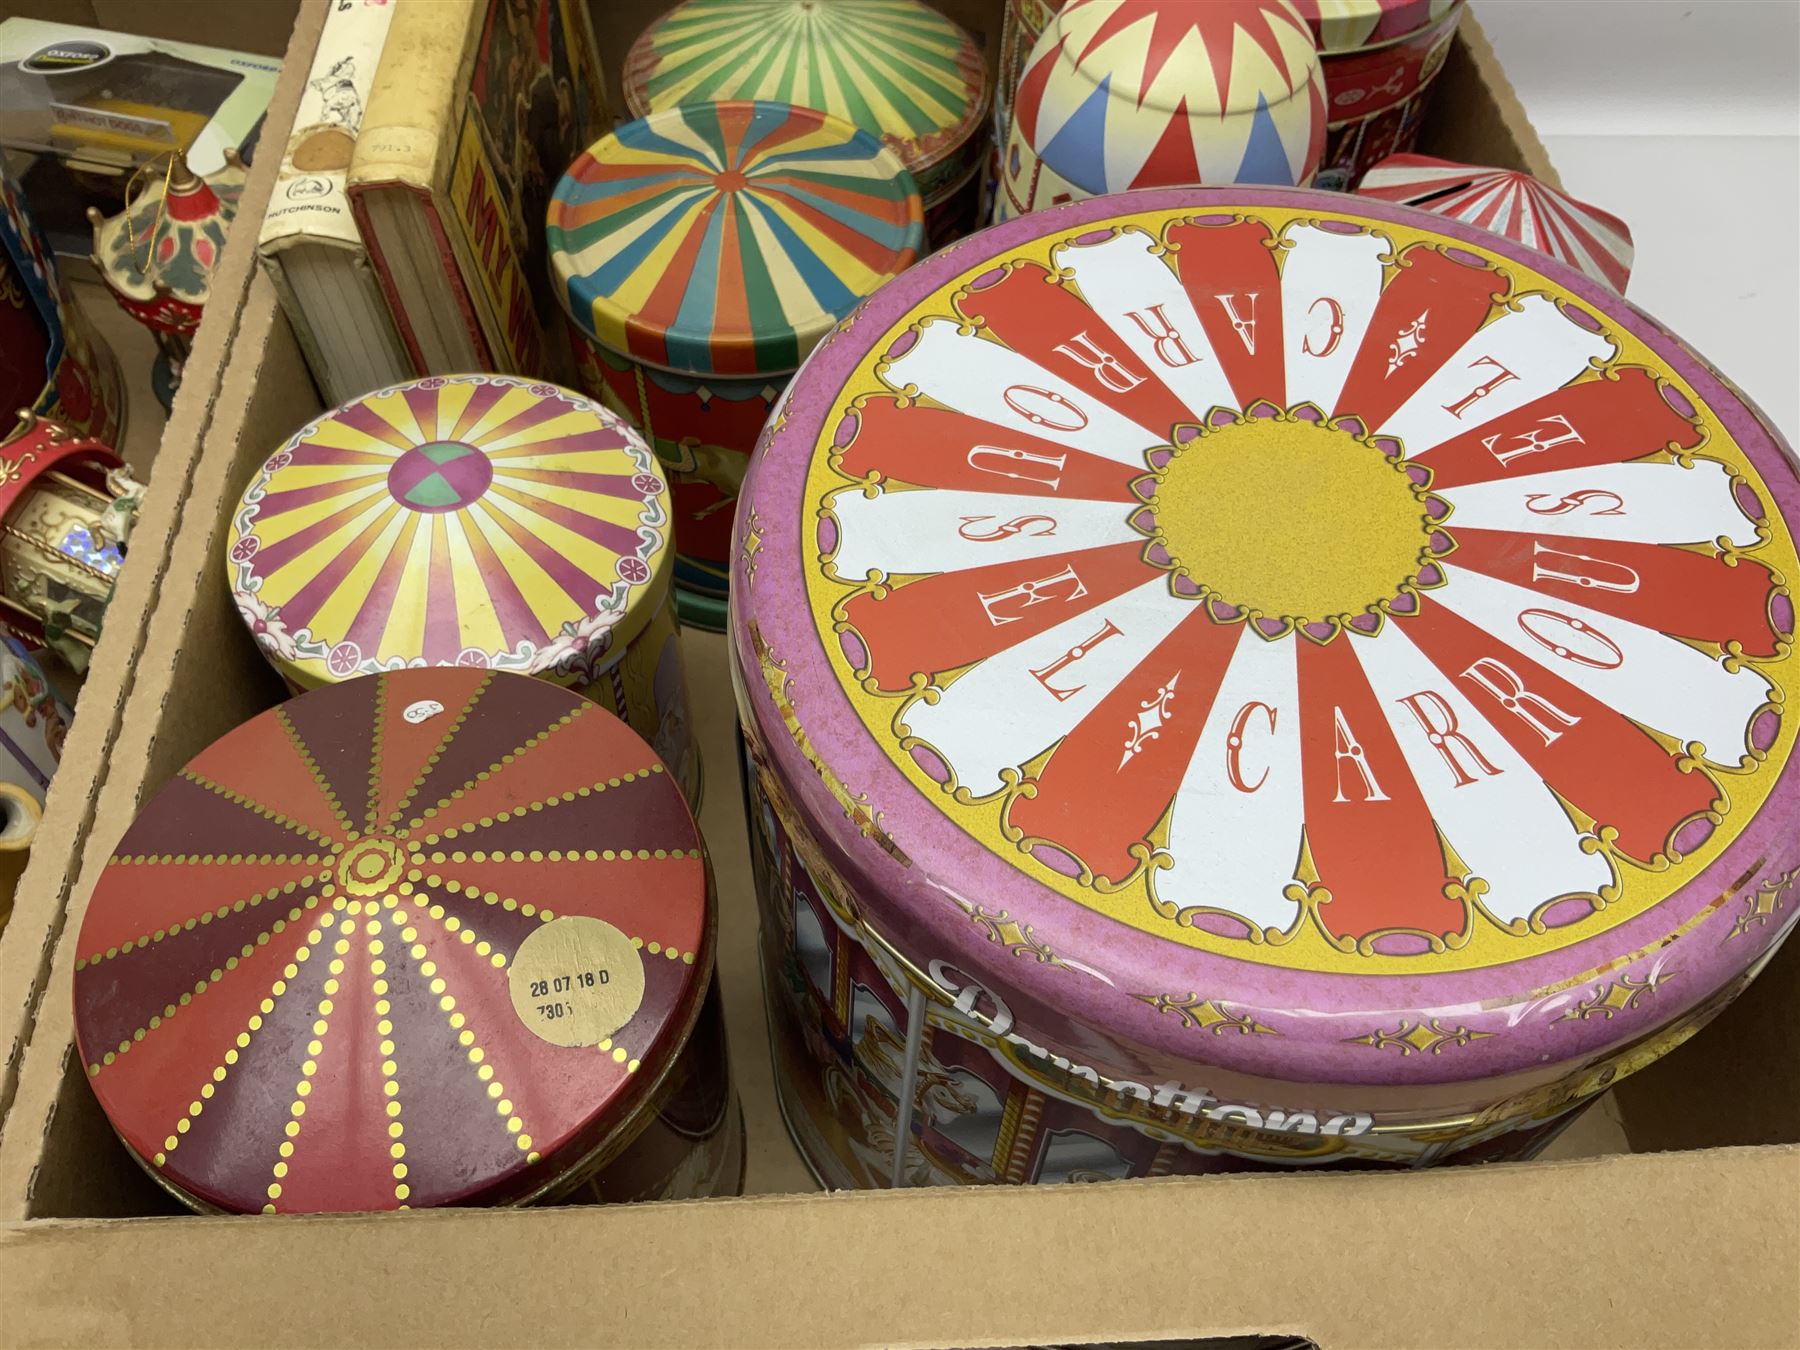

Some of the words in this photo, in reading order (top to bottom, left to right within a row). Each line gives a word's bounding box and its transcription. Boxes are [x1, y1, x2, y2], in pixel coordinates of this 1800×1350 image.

[47, 49, 99, 59] OXFORD
[267, 204, 342, 219] HUTCHINSON
[1226, 355, 1641, 803] CARROUSEL
[530, 980, 549, 998] 28
[553, 976, 571, 993] 07
[576, 972, 595, 988] 18
[598, 969, 610, 985] D
